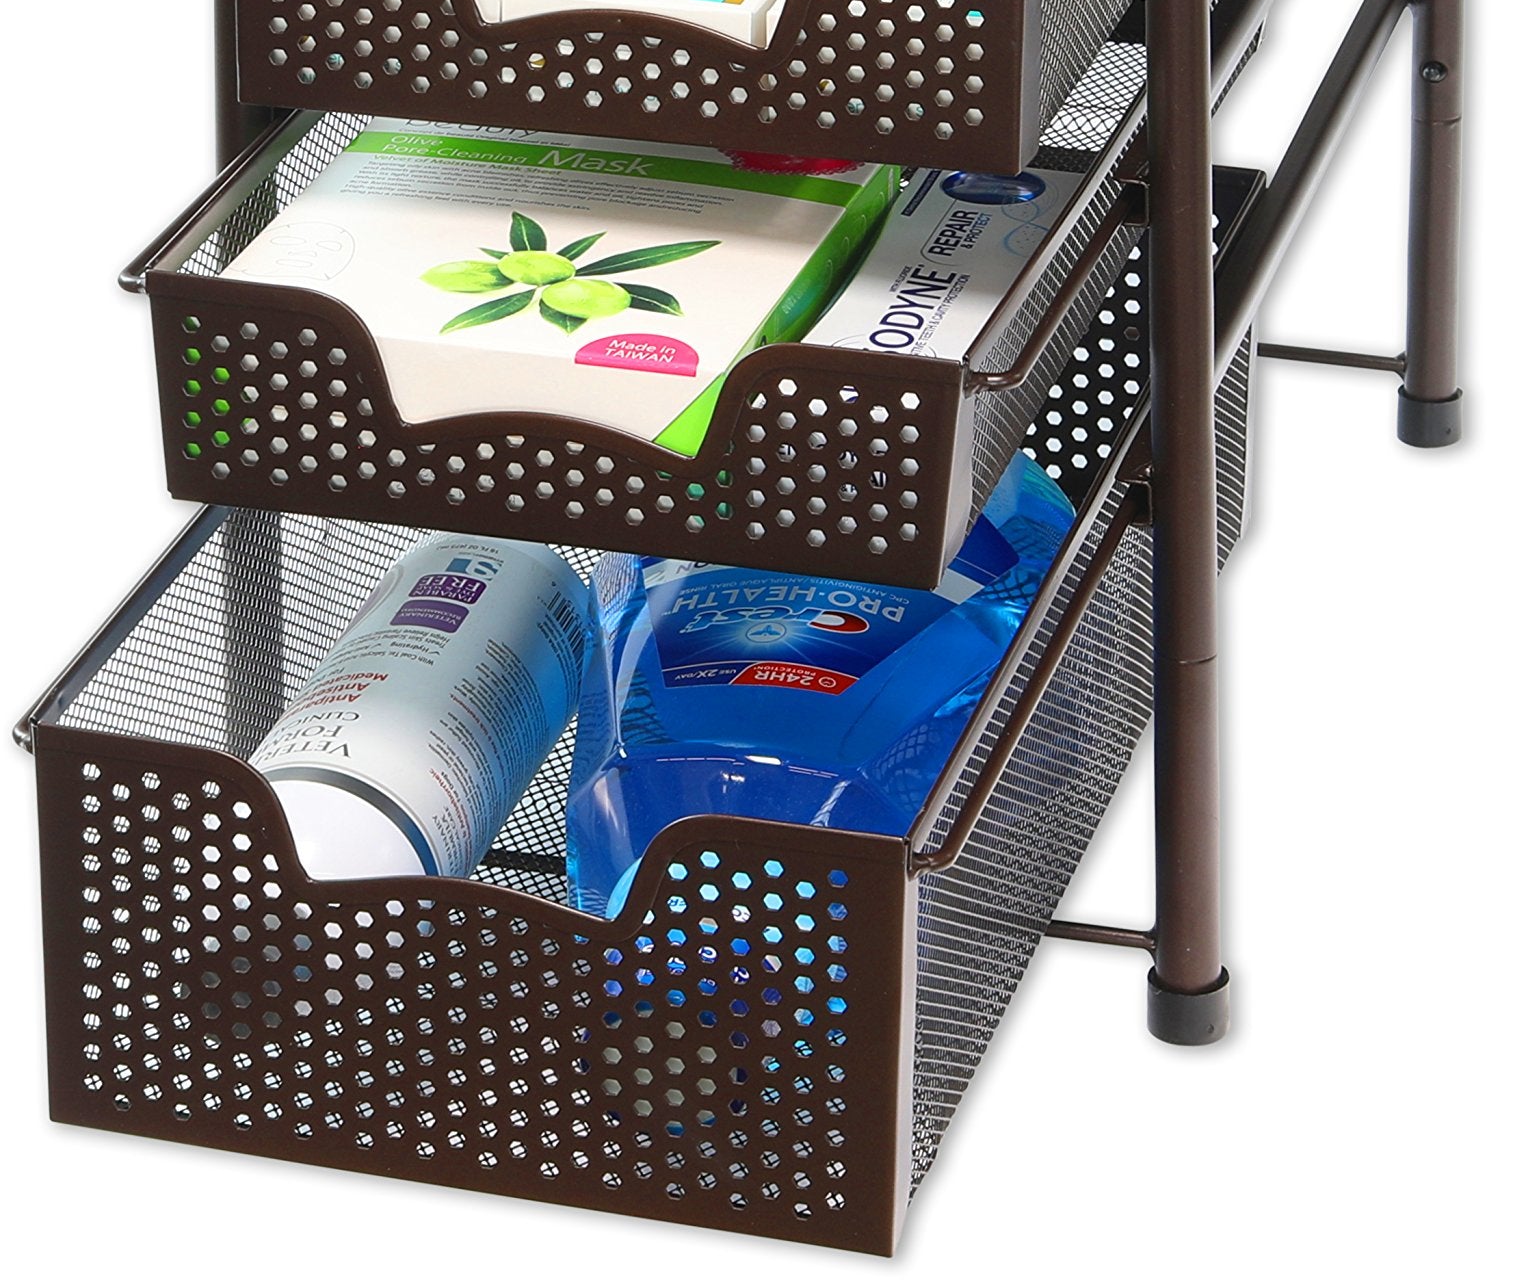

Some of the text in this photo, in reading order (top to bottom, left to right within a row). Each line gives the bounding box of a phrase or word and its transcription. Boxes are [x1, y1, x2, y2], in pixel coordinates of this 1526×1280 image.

[391, 135, 443, 147] Olive
[382, 143, 653, 176] Pore-Cleaning Mask
[928, 210, 978, 256] REPAIR
[965, 213, 993, 243] PROTECT
[868, 266, 957, 348] ODYNE
[609, 339, 676, 354] Made in
[605, 347, 674, 363] TAIWAN
[422, 576, 481, 592] FREE
[679, 585, 708, 595] RINSE
[711, 581, 737, 589] ORAL
[412, 589, 473, 603] PARABEN
[889, 595, 911, 605] CPC
[400, 612, 457, 625] VETERINARY
[680, 605, 870, 634] Crest
[390, 641, 430, 653] Hydrating
[418, 657, 434, 666] With
[674, 668, 719, 680] 2X/DAY
[754, 670, 812, 687] 24HR
